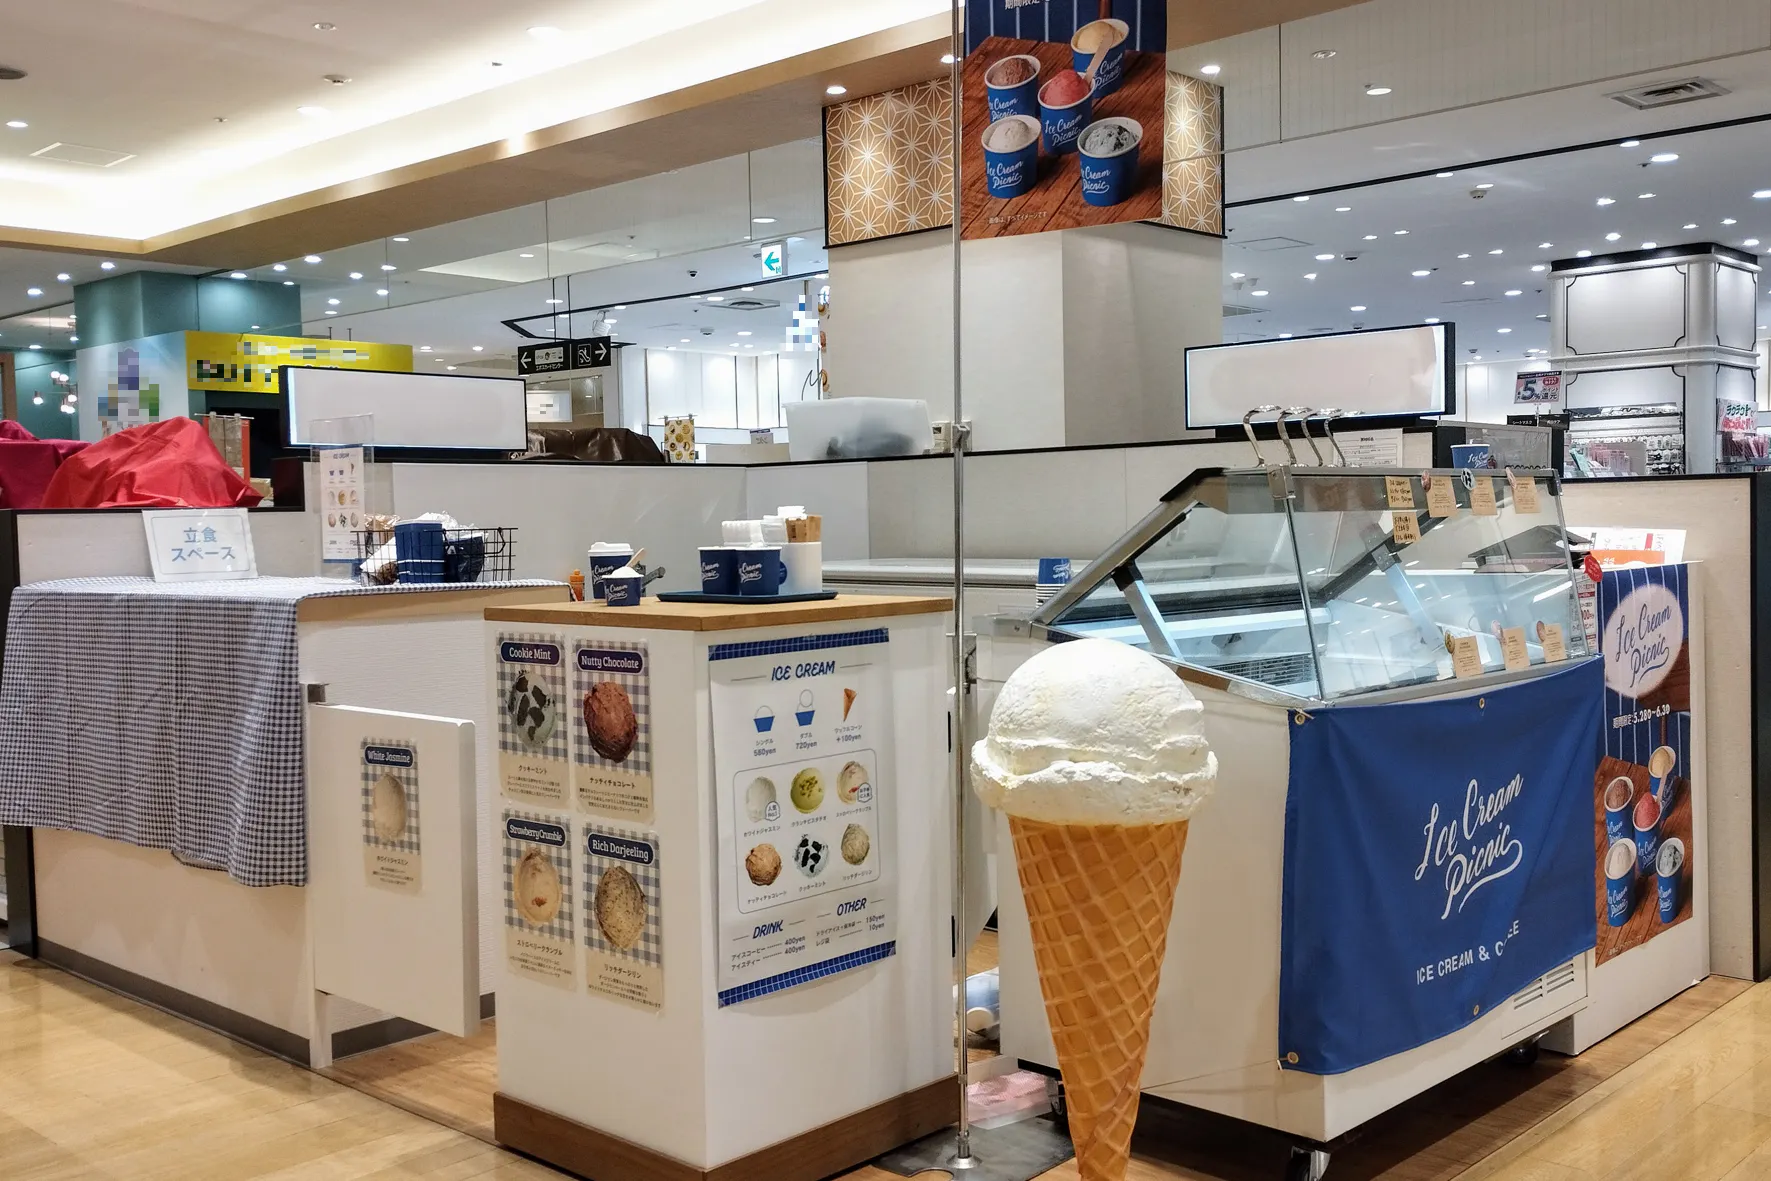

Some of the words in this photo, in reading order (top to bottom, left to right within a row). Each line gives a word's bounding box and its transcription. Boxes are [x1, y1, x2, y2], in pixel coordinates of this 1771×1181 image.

[994, 98, 1019, 110] Cream
[1057, 114, 1082, 130] Cream
[1052, 129, 1081, 147] Picnic
[997, 160, 1023, 174] Cream
[1086, 166, 1111, 180] Cream
[992, 174, 1022, 190] Picnic
[183, 527, 217, 543] 立食
[171, 546, 236, 562] スペース
[1616, 615, 1635, 662] Ice
[1638, 604, 1672, 640] Cream
[509, 647, 532, 658] Cookie
[534, 648, 551, 660] Mint
[581, 656, 602, 668] Nutty
[602, 656, 639, 668] Chocolate
[1630, 633, 1669, 688] Picnic
[772, 666, 792, 682] ICE
[796, 660, 836, 678] CREAM
[796, 741, 818, 750] 720yen
[368, 750, 384, 762] White
[386, 750, 410, 763] Jasmine
[510, 824, 540, 840] Strawberry
[540, 830, 562, 842] Crumble
[1415, 803, 1458, 881] Ice
[1463, 773, 1524, 840] Cream
[592, 840, 608, 852] Rich
[610, 842, 648, 862] Darjeeling
[1441, 822, 1523, 920] Picnic
[837, 898, 867, 916] OTHER
[752, 920, 784, 939] DRINK
[731, 948, 766, 961] アイスコーヒー
[784, 936, 806, 946] 400yen
[731, 958, 760, 971] アイスティー
[784, 945, 806, 954] 400yen
[1416, 965, 1434, 985] ICE
[1438, 949, 1474, 977] CREAM
[1478, 945, 1490, 962] &
